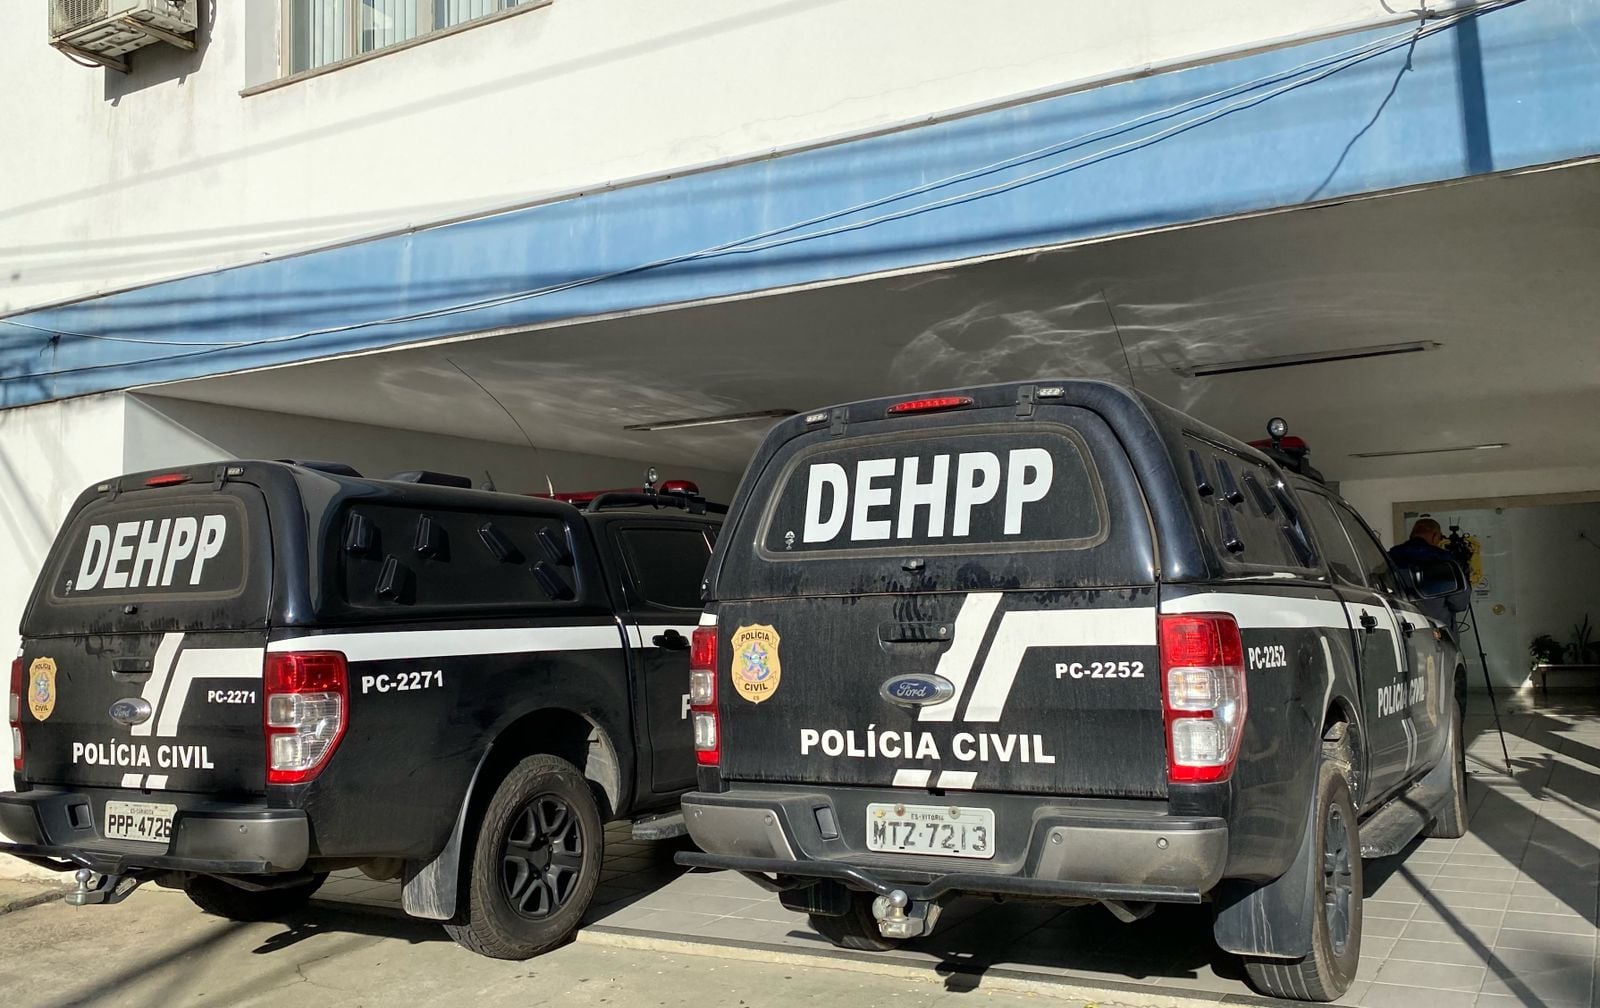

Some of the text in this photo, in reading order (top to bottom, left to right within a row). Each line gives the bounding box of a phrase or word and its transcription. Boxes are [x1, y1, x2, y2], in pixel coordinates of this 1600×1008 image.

[803, 448, 1054, 543] DEHPP
[75, 514, 226, 590] DEHPP
[1248, 645, 1286, 669] PC-2252
[362, 670, 443, 694] PC-2271
[1055, 661, 1145, 679] PC-2252
[207, 691, 256, 704] PC-2271
[744, 683, 768, 691] CIVIL
[896, 681, 927, 697] Ford
[73, 738, 214, 769] POLÍCIA CIVIL
[801, 724, 1055, 764] POLÍCIA CIVIL
